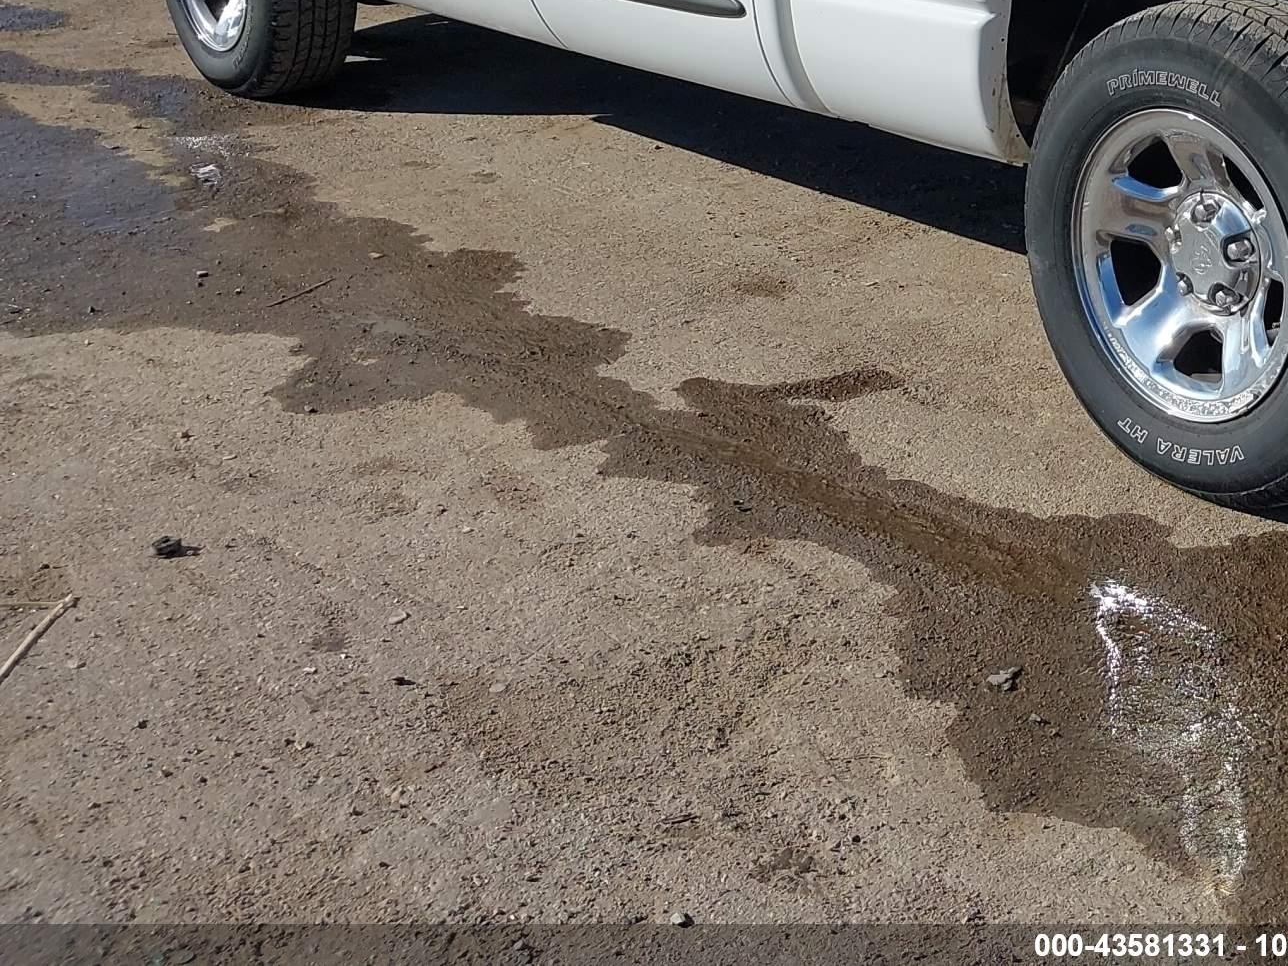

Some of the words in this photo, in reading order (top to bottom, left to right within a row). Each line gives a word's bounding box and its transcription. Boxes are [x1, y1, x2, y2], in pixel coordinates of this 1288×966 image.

[1106, 68, 1221, 107] PRIMEWELL
[1117, 417, 1149, 444] HT
[1156, 437, 1245, 466] VALERA
